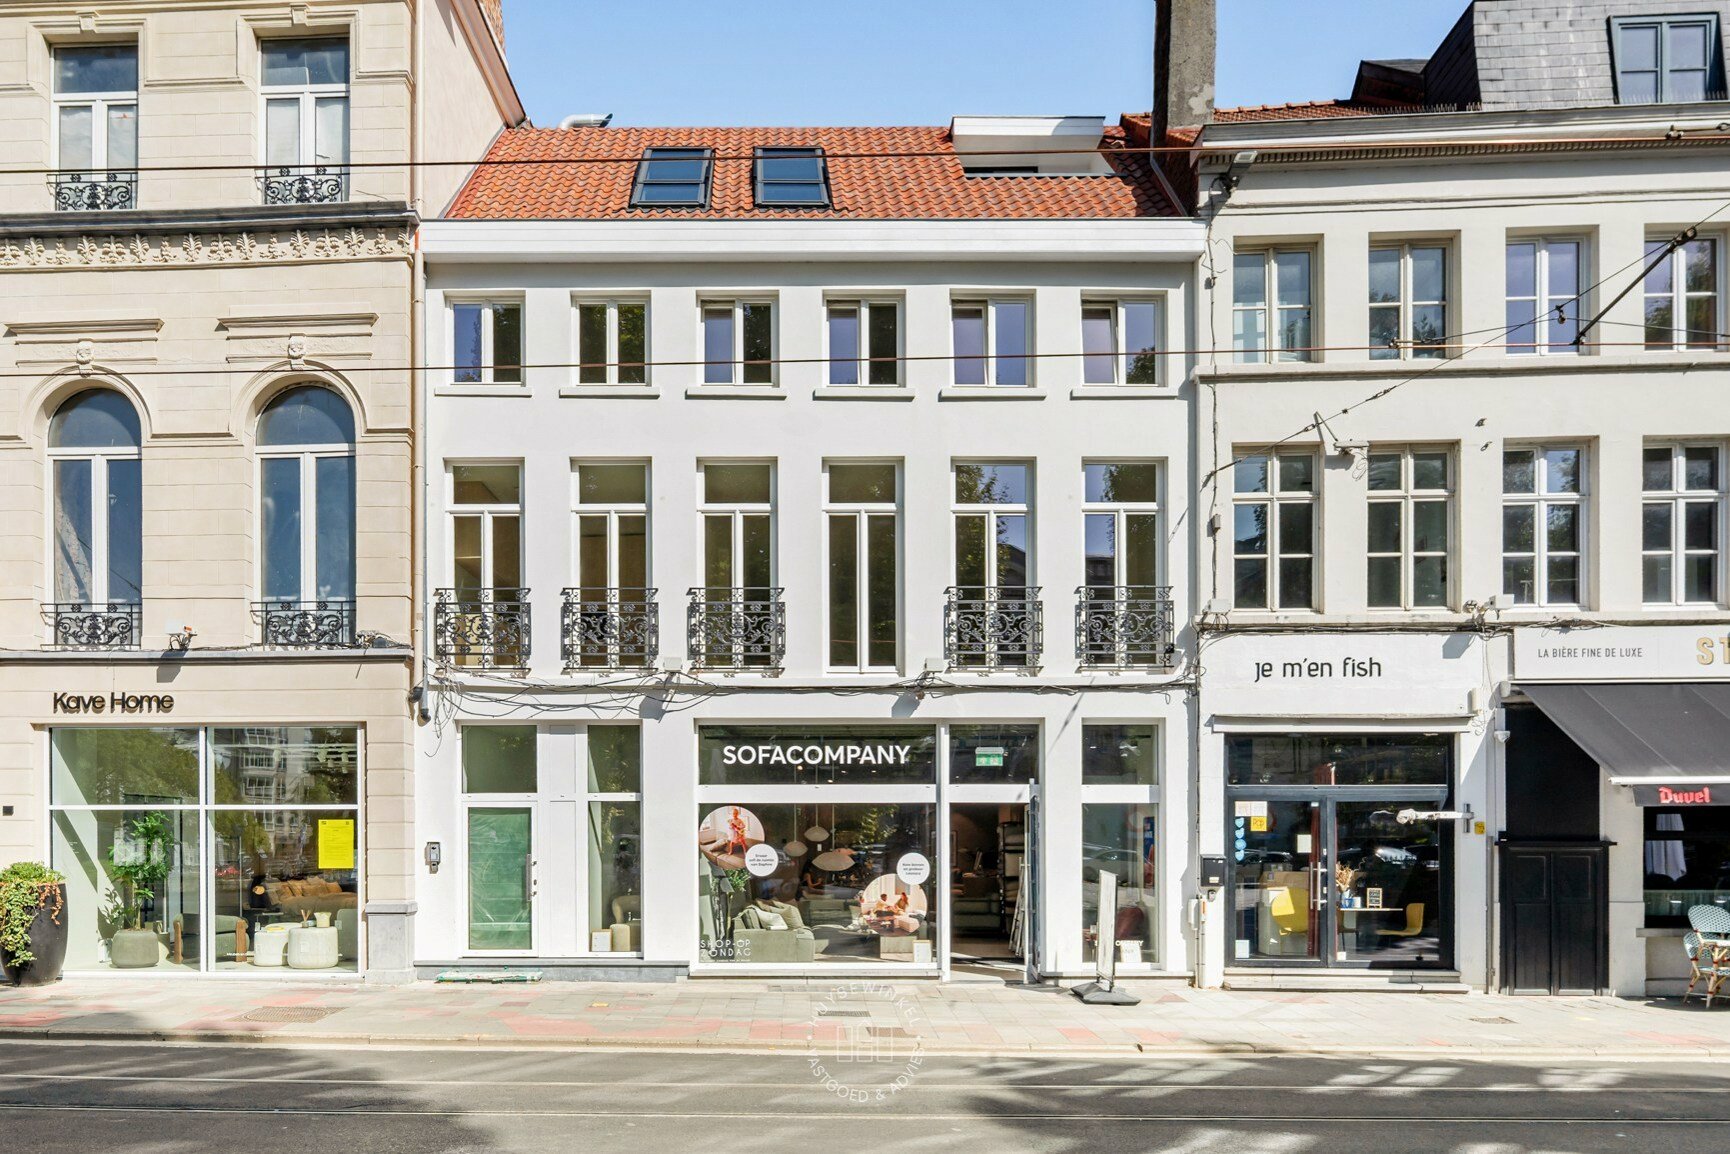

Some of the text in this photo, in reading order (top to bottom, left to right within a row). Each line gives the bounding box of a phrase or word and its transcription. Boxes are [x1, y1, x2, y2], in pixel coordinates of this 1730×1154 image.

[1538, 646, 1643, 658] LA BIÈRE FINE DE LUXE
[1254, 661, 1273, 683] je
[1342, 656, 1382, 678] fish
[53, 691, 175, 711] Kave Home
[722, 744, 911, 765] SOFACOMPANY
[1658, 785, 1712, 804] Duvel
